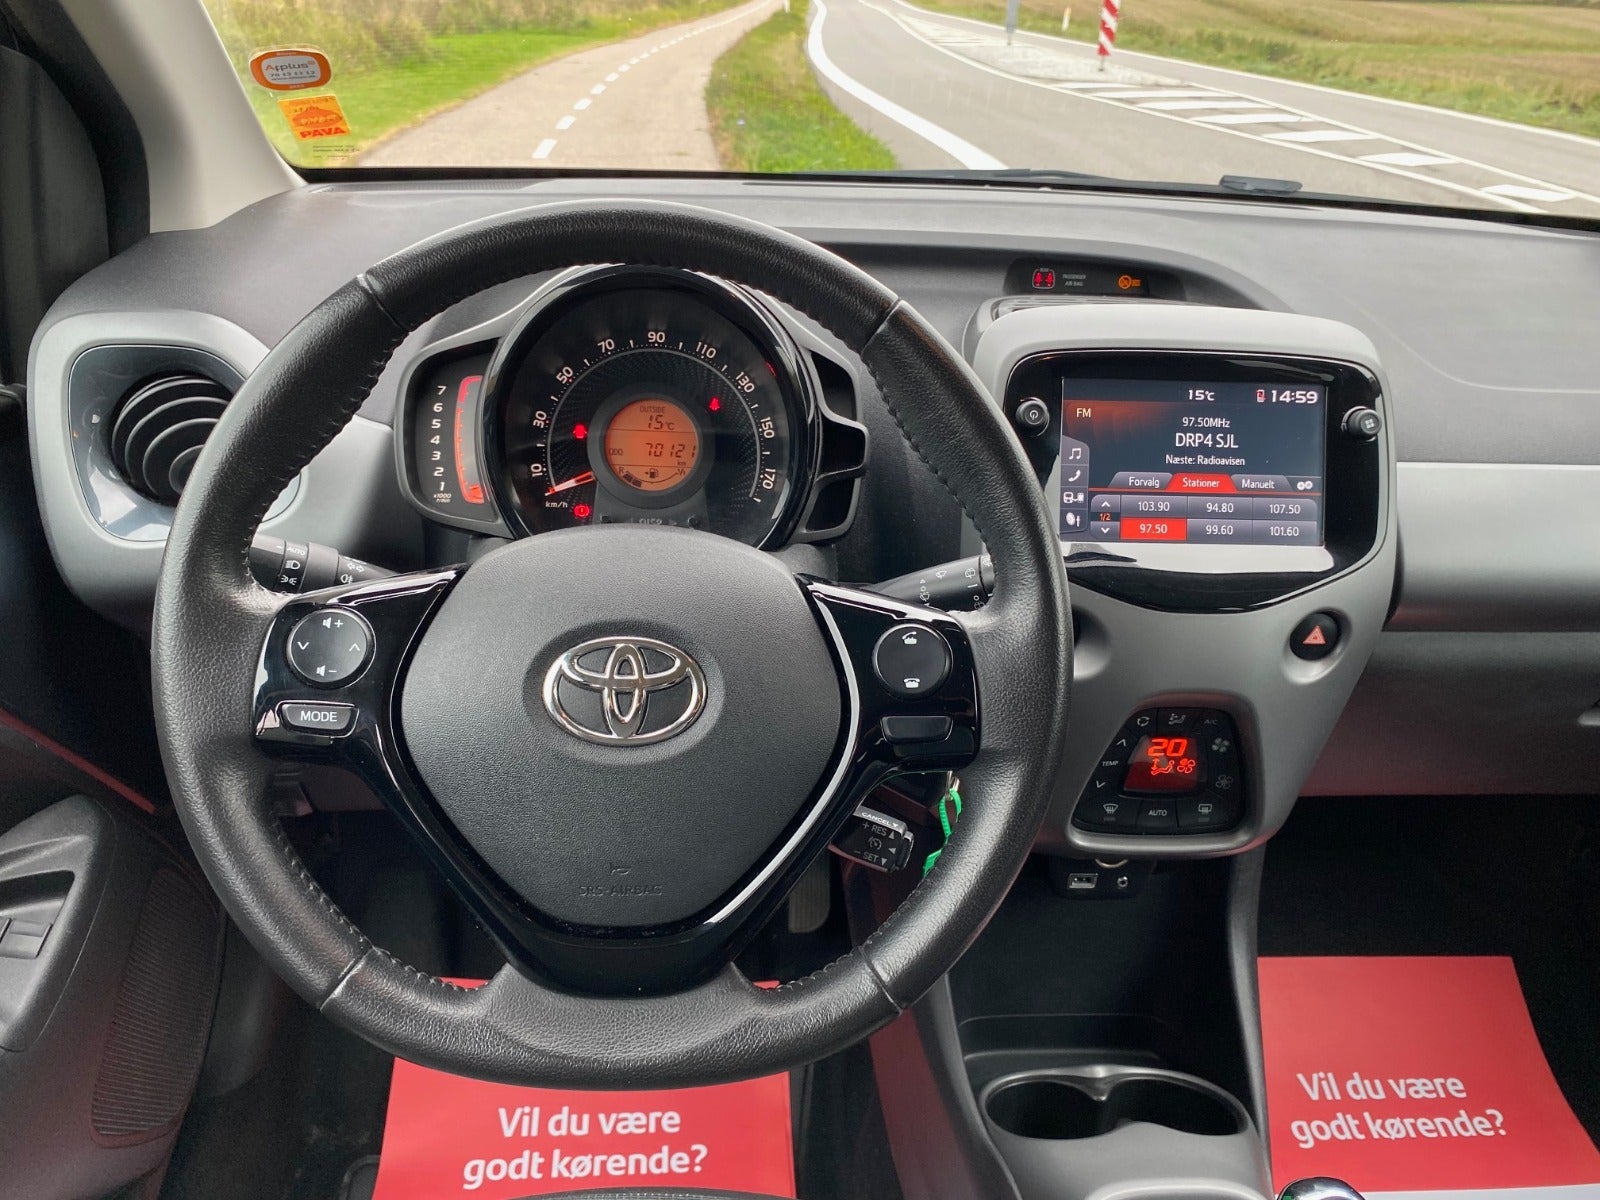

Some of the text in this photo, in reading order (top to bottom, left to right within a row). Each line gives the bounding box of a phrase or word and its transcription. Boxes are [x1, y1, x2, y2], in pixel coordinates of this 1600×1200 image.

[300, 127, 346, 138] PAVA
[648, 332, 666, 343] 90
[598, 338, 616, 354] 70
[696, 342, 717, 358] 110
[556, 366, 574, 384] 50
[735, 372, 755, 392] 130
[437, 386, 447, 395] 7
[1271, 390, 1318, 404] 14:59
[433, 403, 443, 412] 6
[1076, 408, 1092, 418] FM
[432, 419, 441, 428] 5
[533, 410, 546, 428] 30
[1182, 417, 1230, 428] 97.50MHz
[760, 416, 775, 438] 150
[430, 435, 440, 444] 4
[1175, 433, 1239, 448] DRP4 SJL
[432, 451, 441, 460] 3
[645, 442, 697, 458] 70121
[1165, 454, 1245, 466] Næste: Radioavisen
[434, 467, 444, 476] 2
[530, 463, 543, 477] 10
[762, 468, 776, 490] 170
[1128, 476, 1160, 488] Forvalg
[1182, 477, 1220, 488] Stationer
[1241, 479, 1275, 489] Manuelt
[545, 500, 568, 508] km/h
[1138, 501, 1170, 512] 103.90
[1206, 503, 1234, 513] 94.80
[1269, 504, 1301, 514] 107.50
[1100, 513, 1111, 521] 1/2
[1139, 524, 1168, 534] 97.50
[1206, 525, 1233, 535] 99.60
[1269, 526, 1299, 536] 101.60
[300, 710, 337, 722] MODE
[1147, 738, 1188, 756] 20
[862, 812, 890, 825] CANCEL
[872, 825, 887, 836] RES
[863, 852, 879, 862] SET
[1296, 1071, 1467, 1101] Vil du være
[498, 1106, 681, 1138] Vil du være
[1291, 1108, 1507, 1149] godt kørende?
[462, 1143, 708, 1190] godt kørende?
